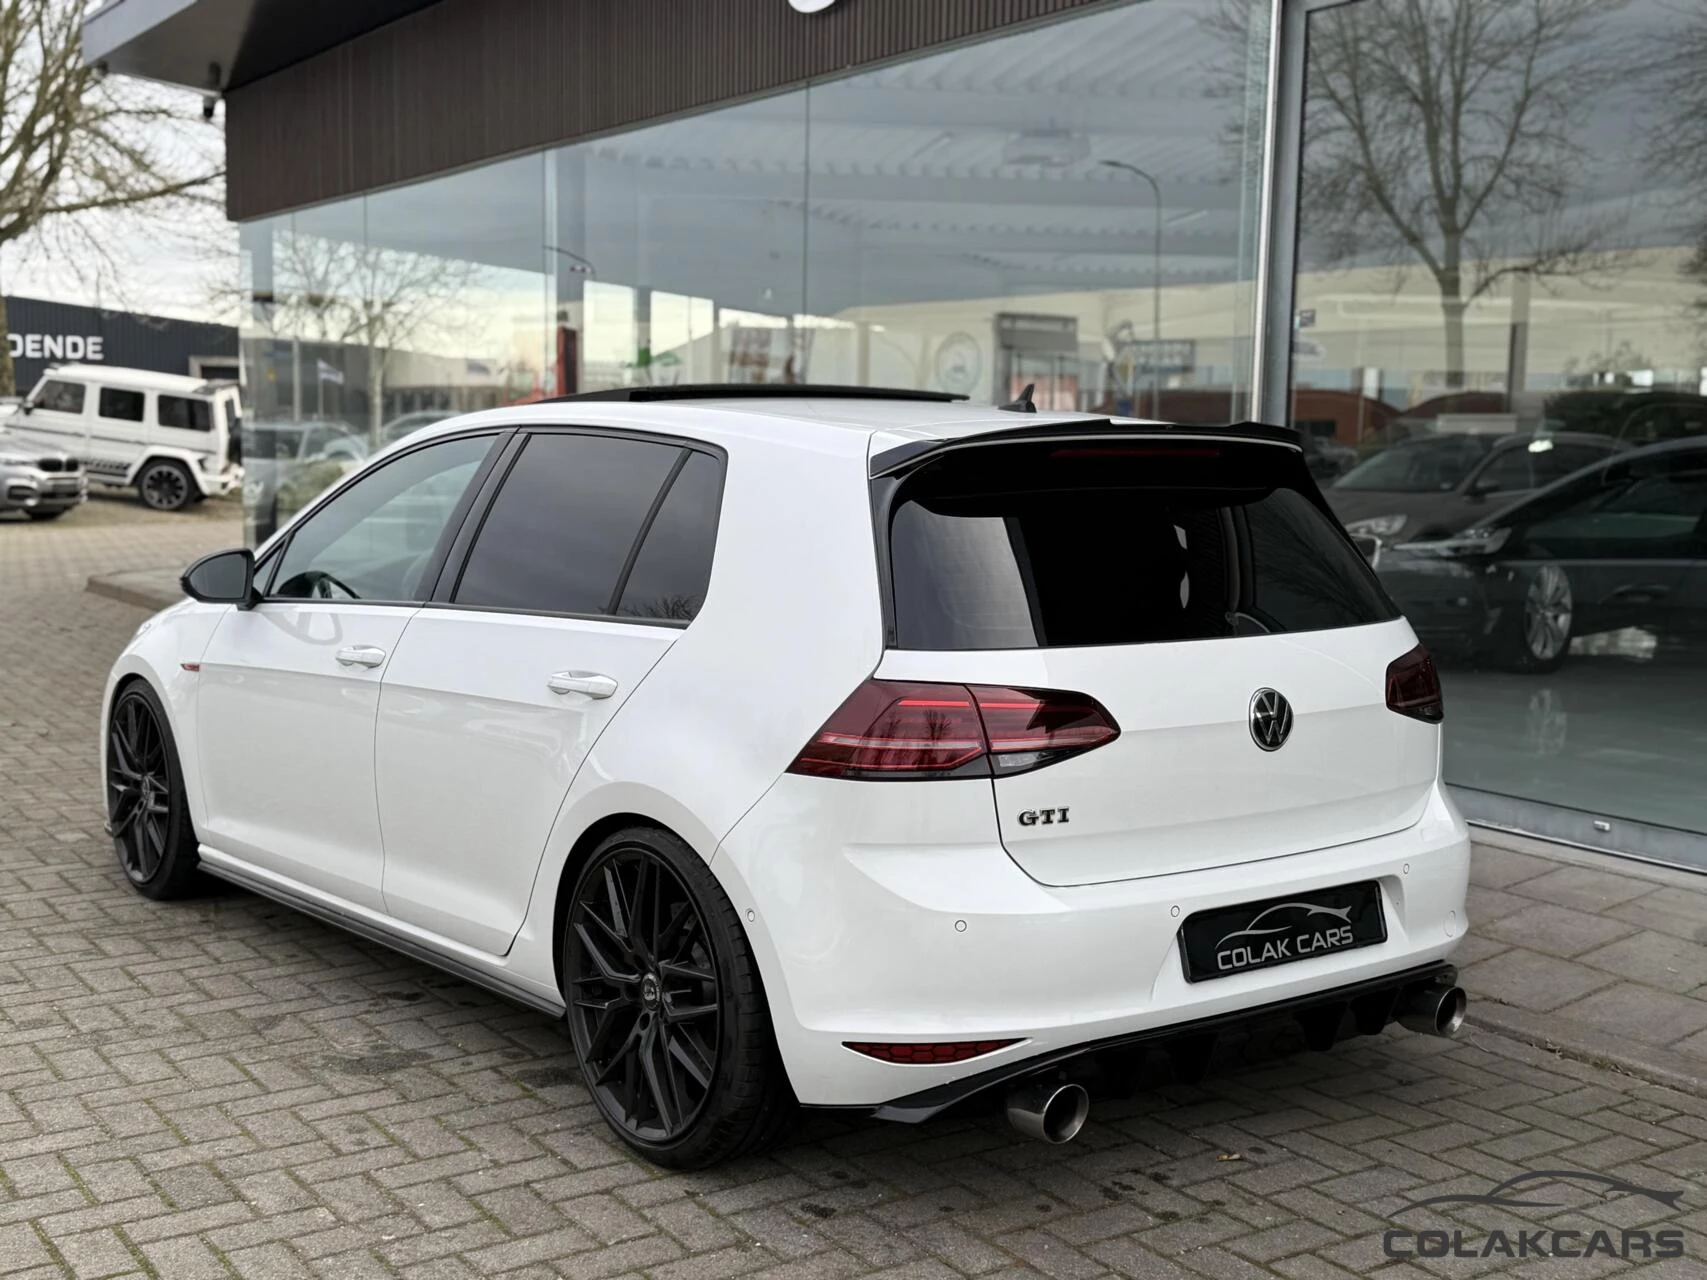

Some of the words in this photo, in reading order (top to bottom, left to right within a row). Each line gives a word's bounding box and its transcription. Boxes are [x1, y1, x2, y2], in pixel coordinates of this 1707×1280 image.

[1018, 807, 1070, 826] GTI
[1217, 938, 1291, 970] COLAK
[1296, 926, 1354, 953] CARS
